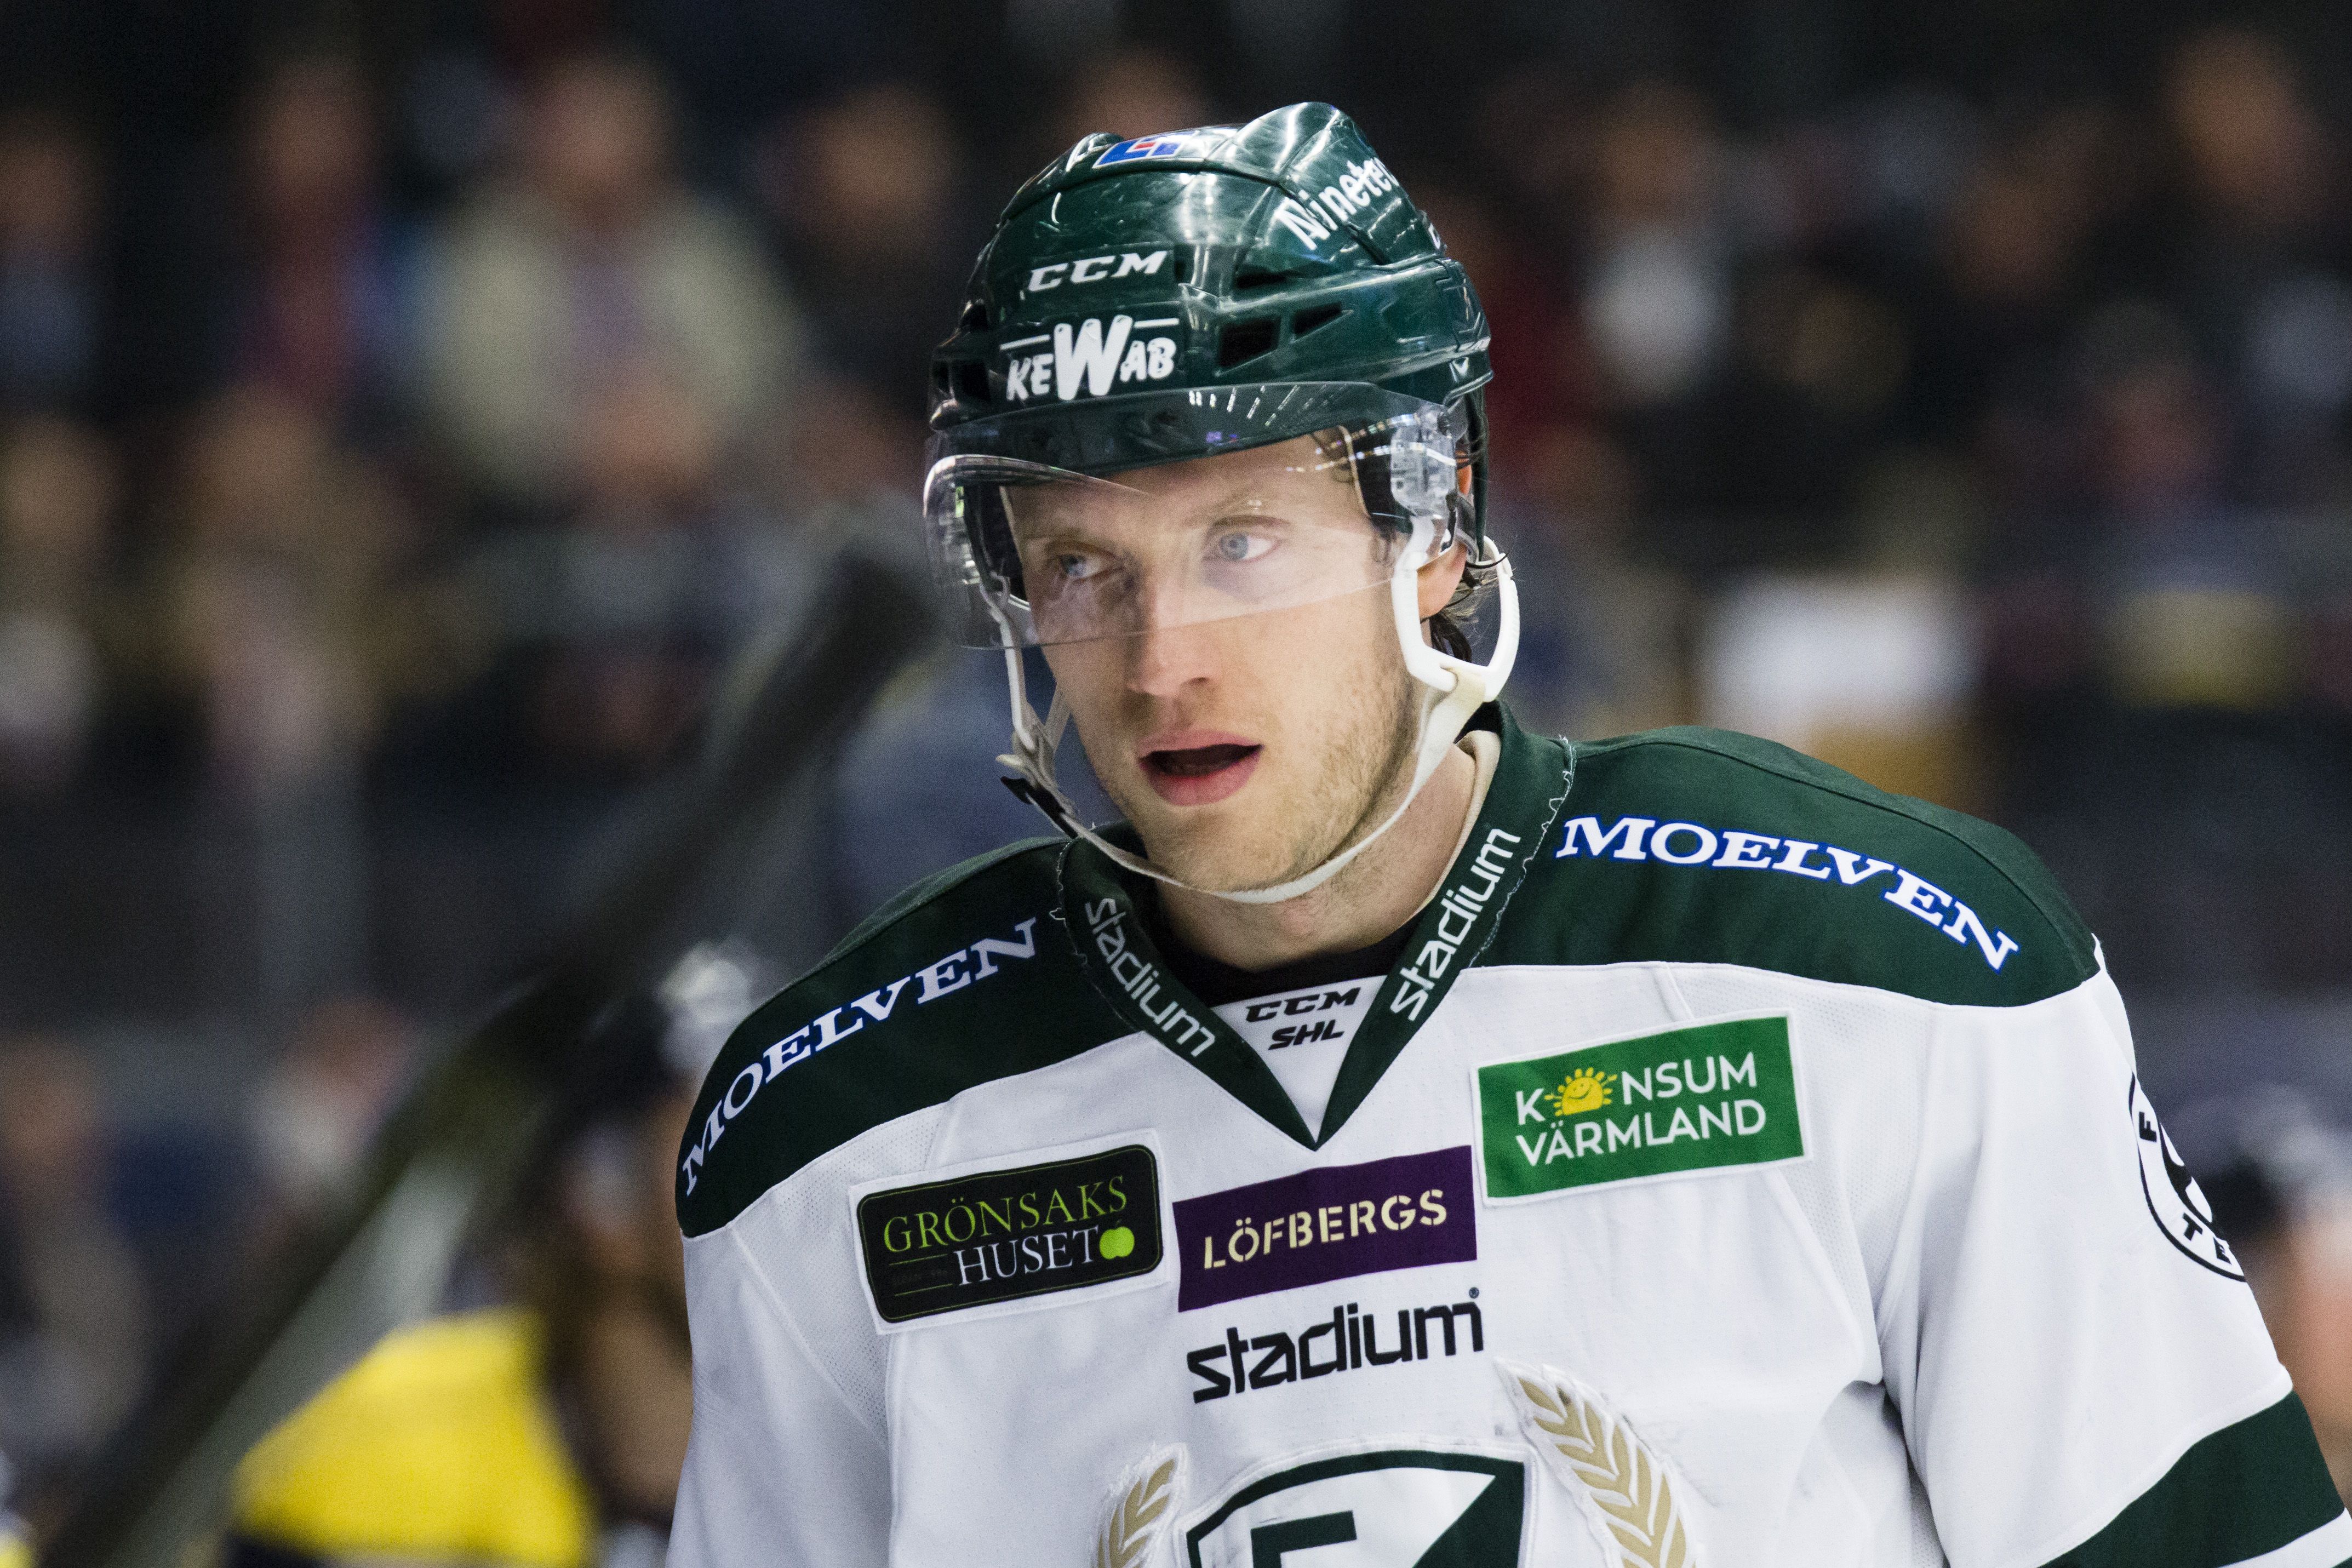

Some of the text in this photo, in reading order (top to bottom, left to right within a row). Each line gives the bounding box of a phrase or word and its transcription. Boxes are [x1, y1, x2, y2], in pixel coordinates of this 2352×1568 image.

[1028, 250, 1168, 292] CCM
[1389, 827, 1521, 1021] stadium
[1554, 816, 2019, 972] MOELVEN
[1085, 897, 1216, 1057] stadium
[1245, 987, 1361, 1022] CCM
[682, 916, 1038, 1197] MOELVEN
[1268, 1019, 1345, 1050] SHL
[1515, 1097, 1766, 1168] VÄRMLAND
[883, 1175, 1129, 1252] GRÖNSAKS
[1204, 1189, 1447, 1270] LÖFBERGS
[953, 1225, 1098, 1286] HUSET
